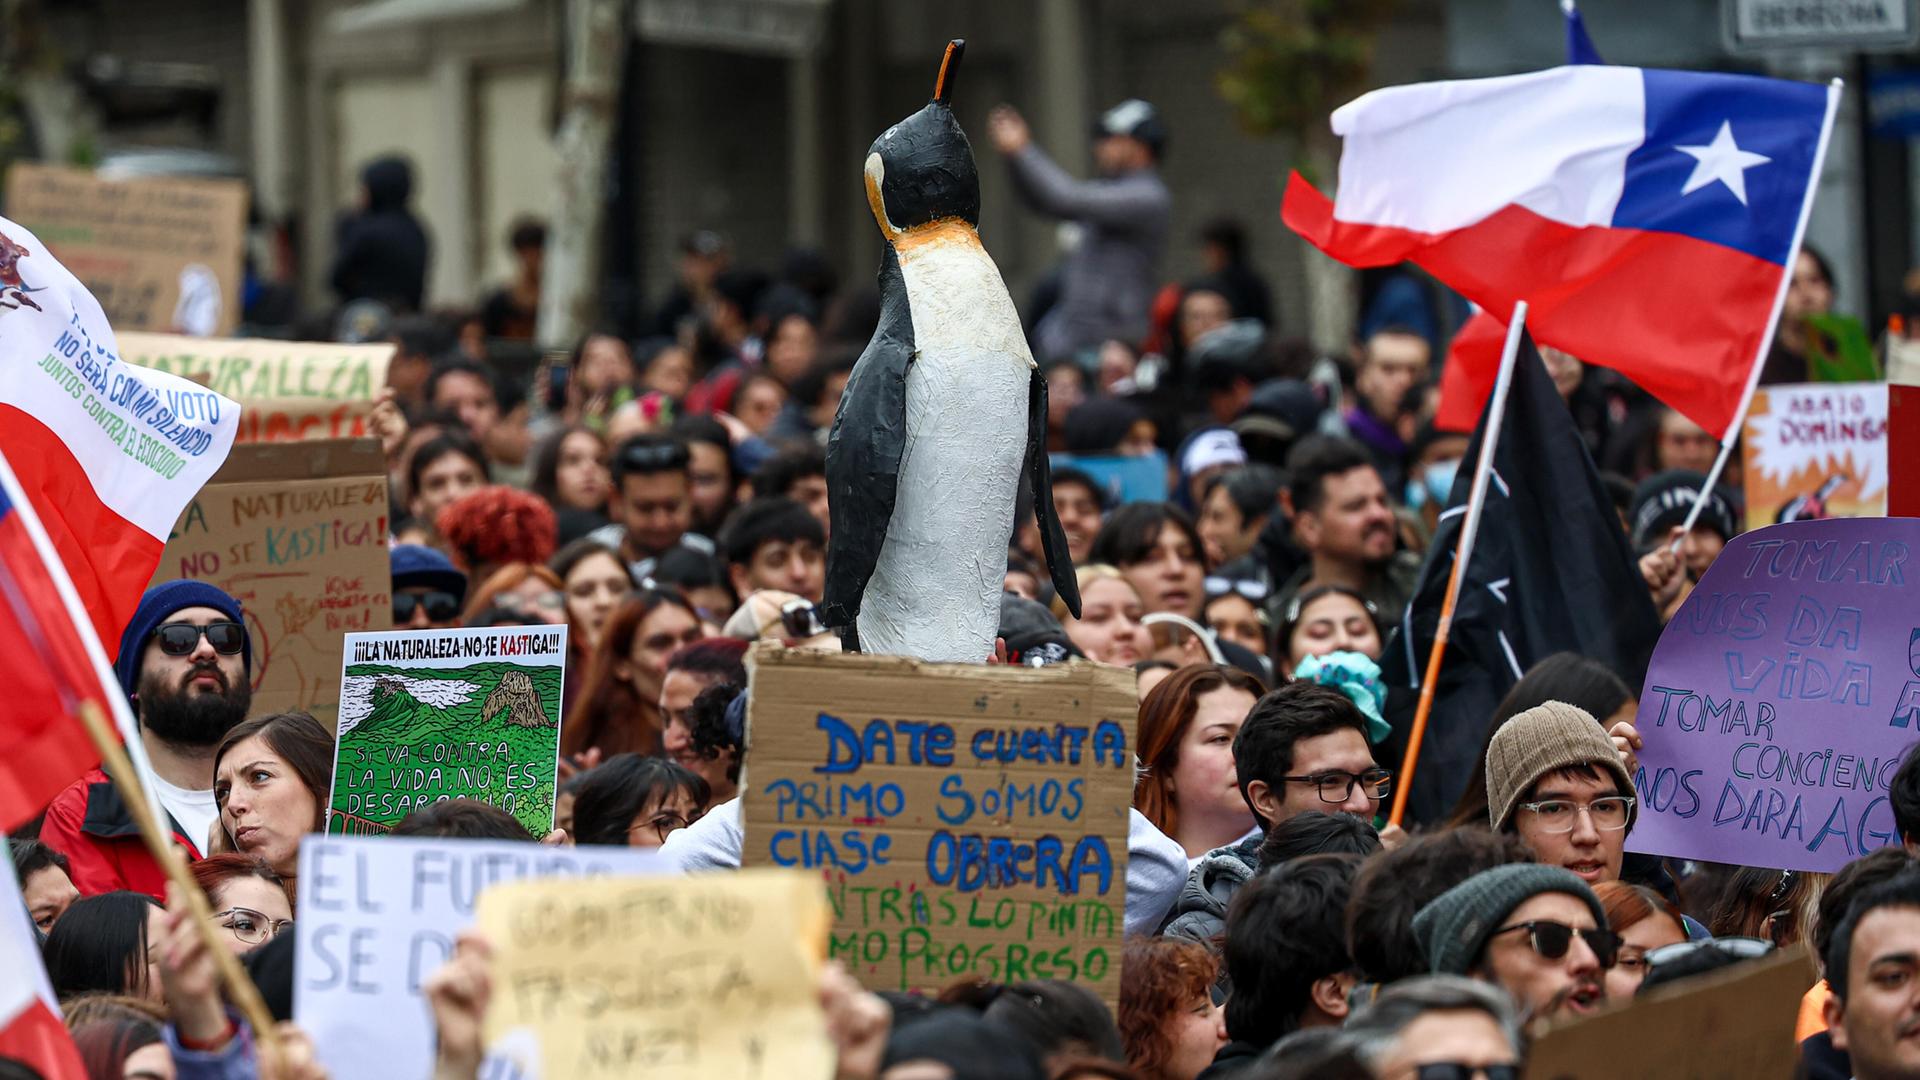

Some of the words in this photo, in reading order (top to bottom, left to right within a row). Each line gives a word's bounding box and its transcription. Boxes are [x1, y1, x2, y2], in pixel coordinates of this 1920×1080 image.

[38, 353, 85, 400] JUNTOS
[82, 394, 129, 447] CONTRA
[53, 330, 80, 358] NO
[147, 407, 213, 457] SILENCIO
[166, 389, 220, 425] VOTO
[232, 482, 385, 526] NATURALEZA
[180, 551, 220, 579] NO
[229, 541, 256, 564] SE
[1744, 538, 1910, 587] TOMAR
[1673, 592, 1774, 641] NOS
[1784, 594, 1864, 652] DA
[383, 637, 460, 661] NATURALEZA
[463, 636, 483, 657] NO
[484, 636, 497, 656] SE
[499, 633, 560, 656] KASTIGA!!!
[1651, 685, 1777, 742] TOMAR
[348, 769, 375, 789] LA
[457, 765, 491, 789] NO
[506, 763, 538, 789] ES
[385, 745, 410, 764] VA
[418, 742, 510, 763] CONTRA
[1634, 765, 1703, 819] NOS
[1713, 777, 1804, 842] DARA
[308, 844, 385, 914] EL
[967, 897, 1016, 930] LO
[304, 923, 380, 995] SE
[829, 930, 889, 970] MO
